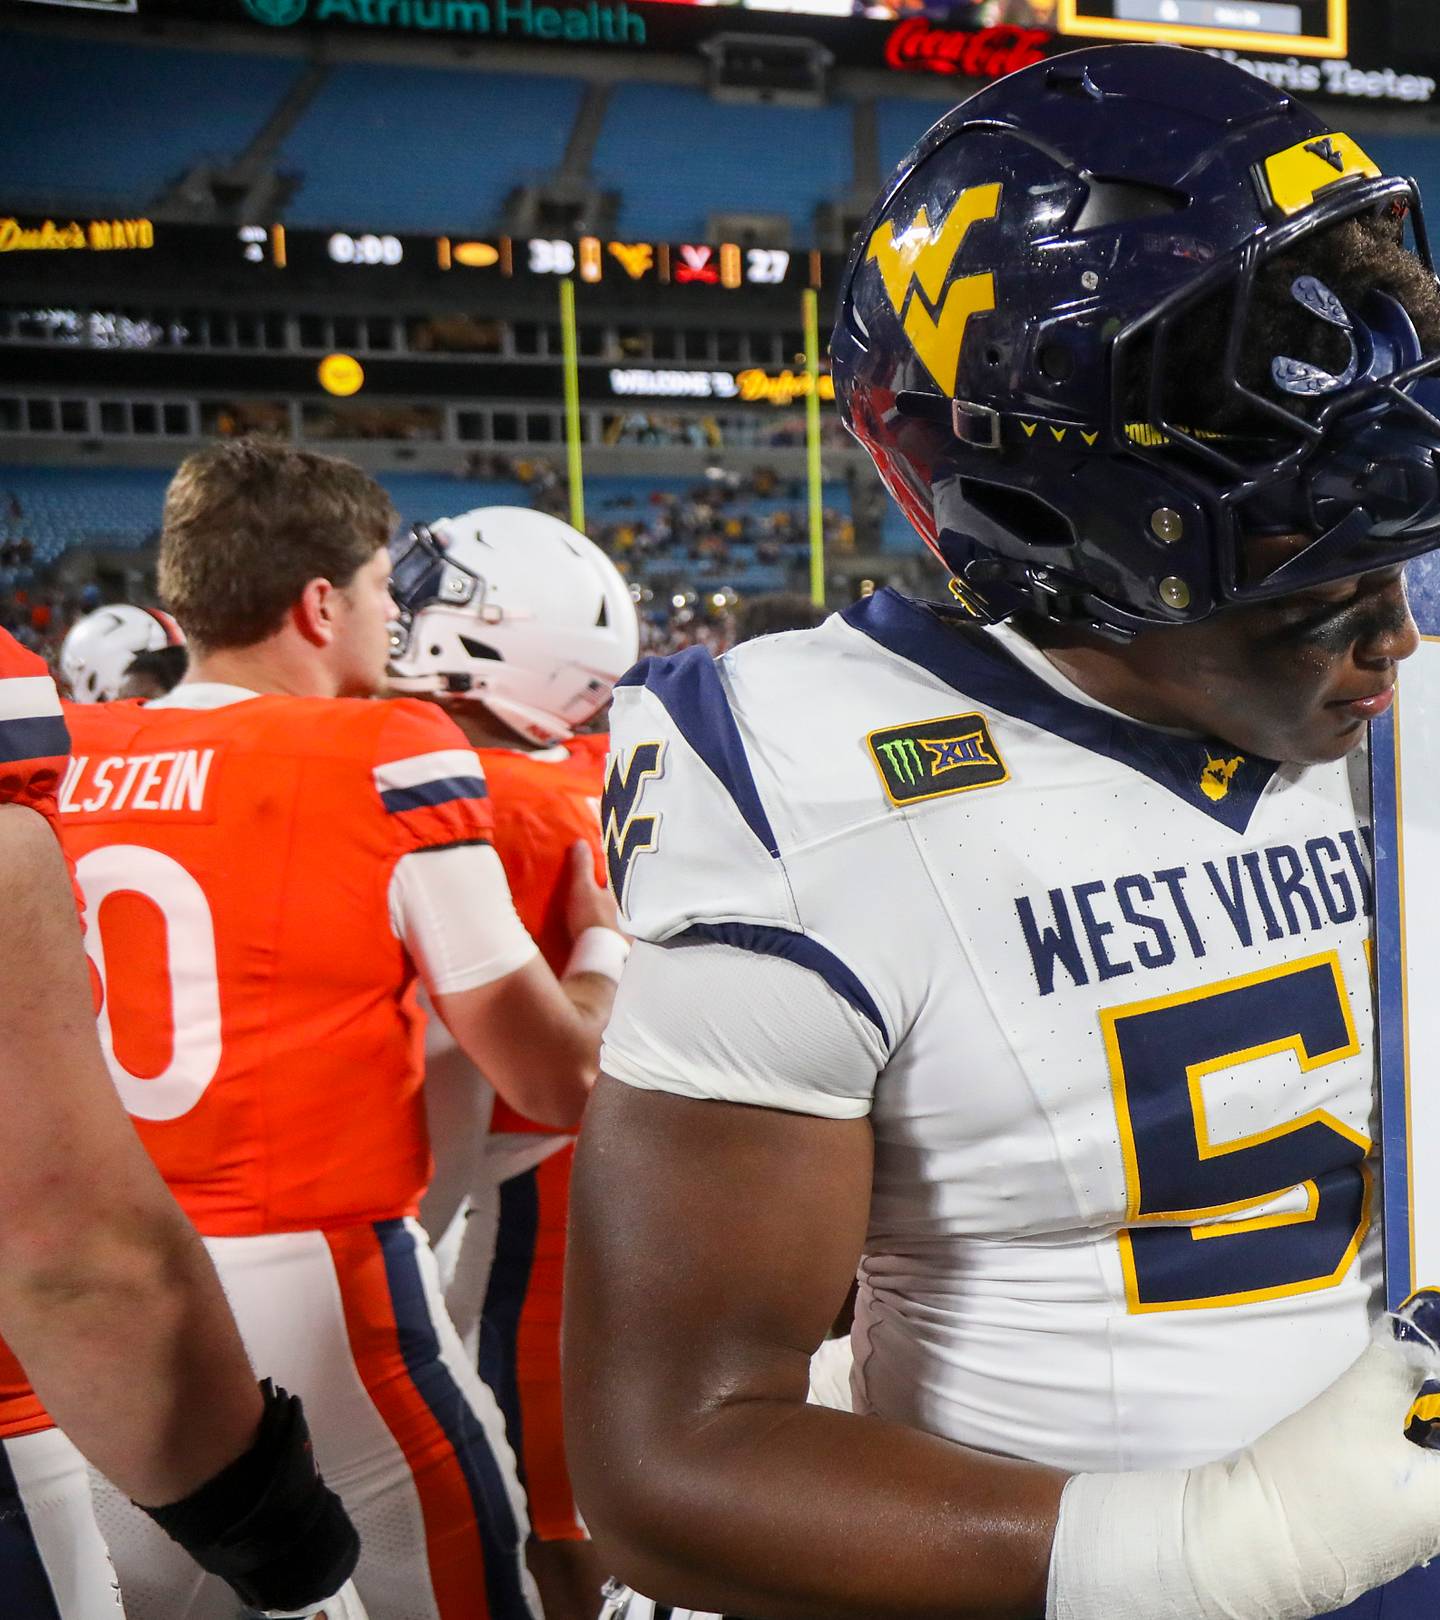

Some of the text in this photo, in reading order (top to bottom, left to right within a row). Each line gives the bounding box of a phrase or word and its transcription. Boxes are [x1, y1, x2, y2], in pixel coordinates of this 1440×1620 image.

[315, 0, 647, 44] Atrium Health
[1203, 49, 1437, 102] orris Teeter
[328, 233, 403, 266] 0:00
[747, 248, 790, 284] 27
[1014, 826, 1374, 996] WEST VIRGI
[1097, 948, 1374, 1317] 5
